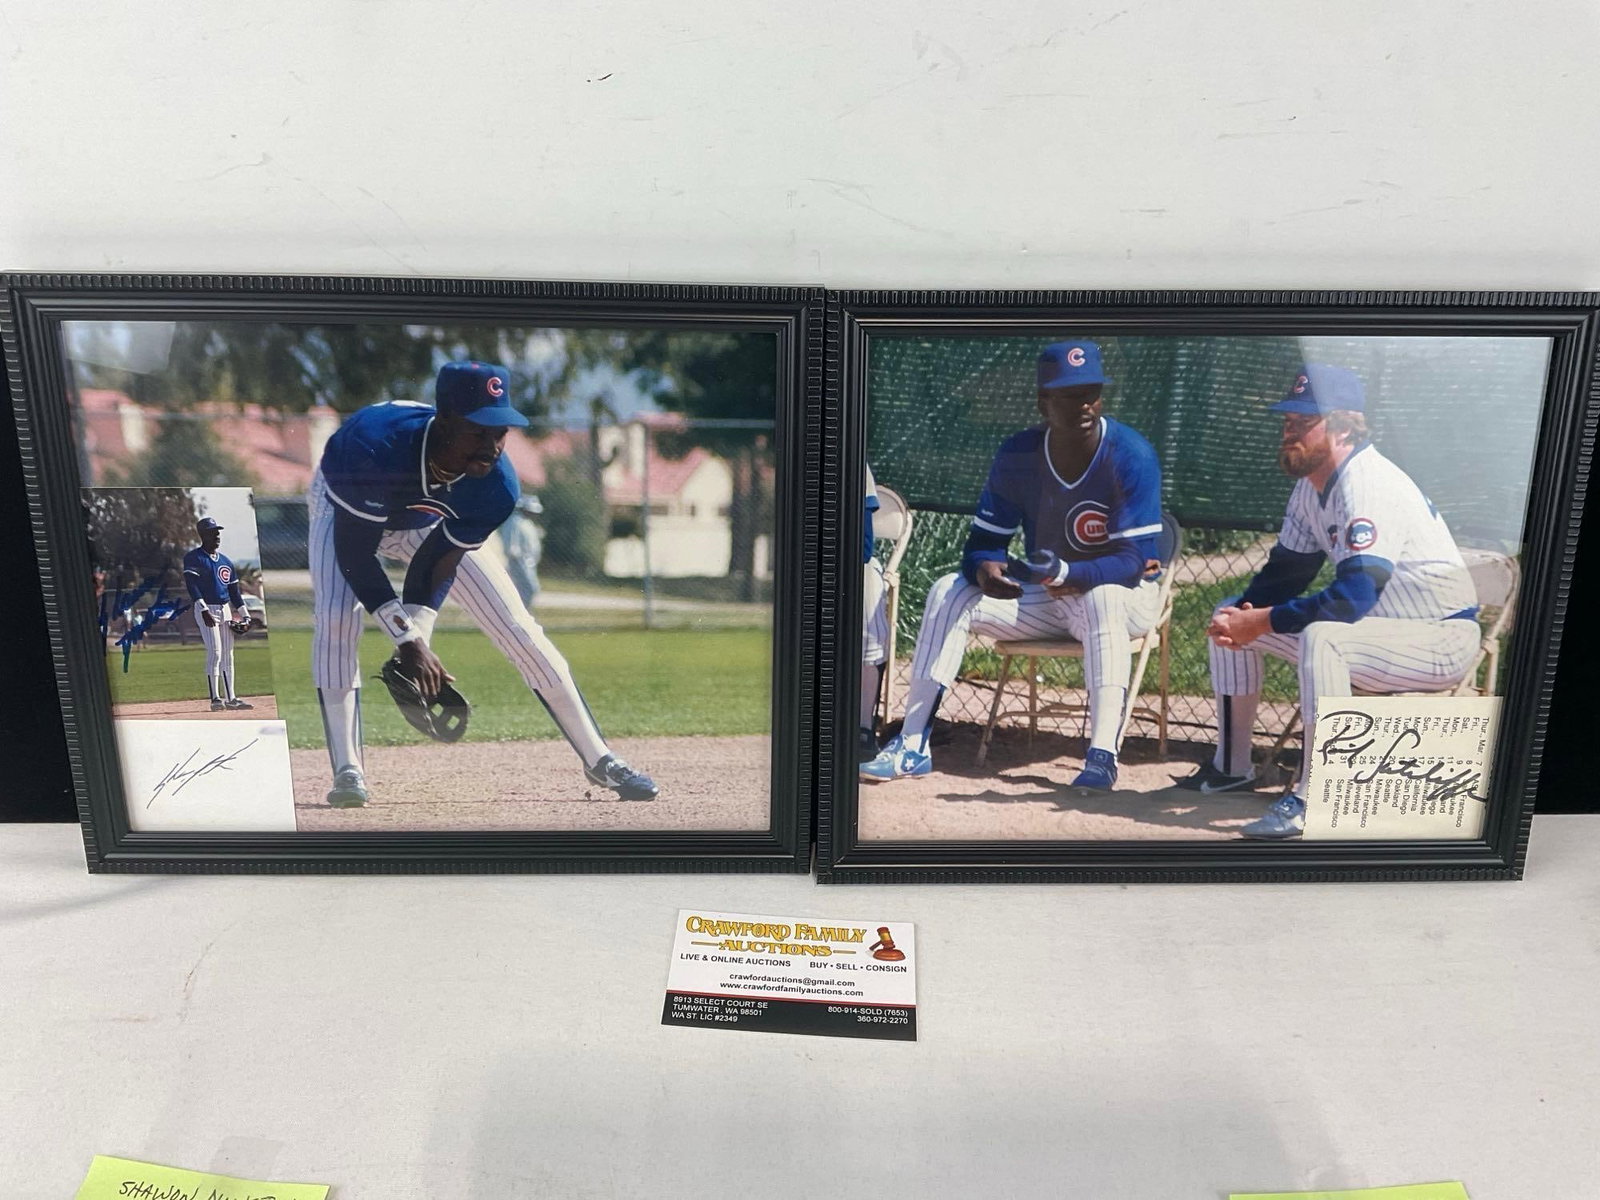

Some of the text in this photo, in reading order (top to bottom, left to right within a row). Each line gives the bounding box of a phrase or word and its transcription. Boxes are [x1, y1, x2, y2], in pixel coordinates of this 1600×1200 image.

[1067, 347, 1086, 367] C
[486, 376, 505, 398] C
[1339, 755, 1348, 764] 31
[1359, 755, 1367, 765] 25
[1369, 755, 1377, 765] 24
[1418, 756, 1426, 765] 17
[1427, 756, 1435, 765] 15
[1447, 756, 1455, 764] 11
[1322, 778, 1333, 803] Seattle
[1336, 778, 1345, 793] San
[1382, 778, 1394, 803] Seattle
[1392, 778, 1403, 808] Oakland
[1403, 779, 1413, 793] San
[1342, 778, 1354, 815] Milwaukee
[1352, 780, 1364, 814] leveland
[1371, 778, 1383, 815] Milwaukee
[1410, 779, 1423, 812] California
[1330, 794, 1343, 828] Francisco
[1359, 794, 1372, 828] Francisco
[1400, 794, 1411, 815] Diego
[1455, 794, 1468, 828] Francisco
[686, 916, 867, 943] CRAWFORD FAMILY
[719, 939, 833, 957] AUCTIONS
[680, 953, 791, 968] LIVE & ONLINE AUCTIONS
[810, 961, 908, 974] BUY SELL CONSIGN
[729, 972, 856, 988] crawfordauctions@gmail.com
[719, 982, 864, 998] www.crawfordfamilyauctions.com
[672, 1003, 720, 1014] TUMWATER
[725, 1007, 739, 1015] WA
[740, 1008, 763, 1016] 98501
[673, 996, 769, 1010] 8913 SELECT COURT SE
[828, 1006, 883, 1016] 800-914-SOLD
[671, 1011, 685, 1019] WA
[700, 1013, 713, 1021] LIC
[714, 1014, 738, 1022] #2349
[857, 1015, 909, 1025] 360-972-2270
